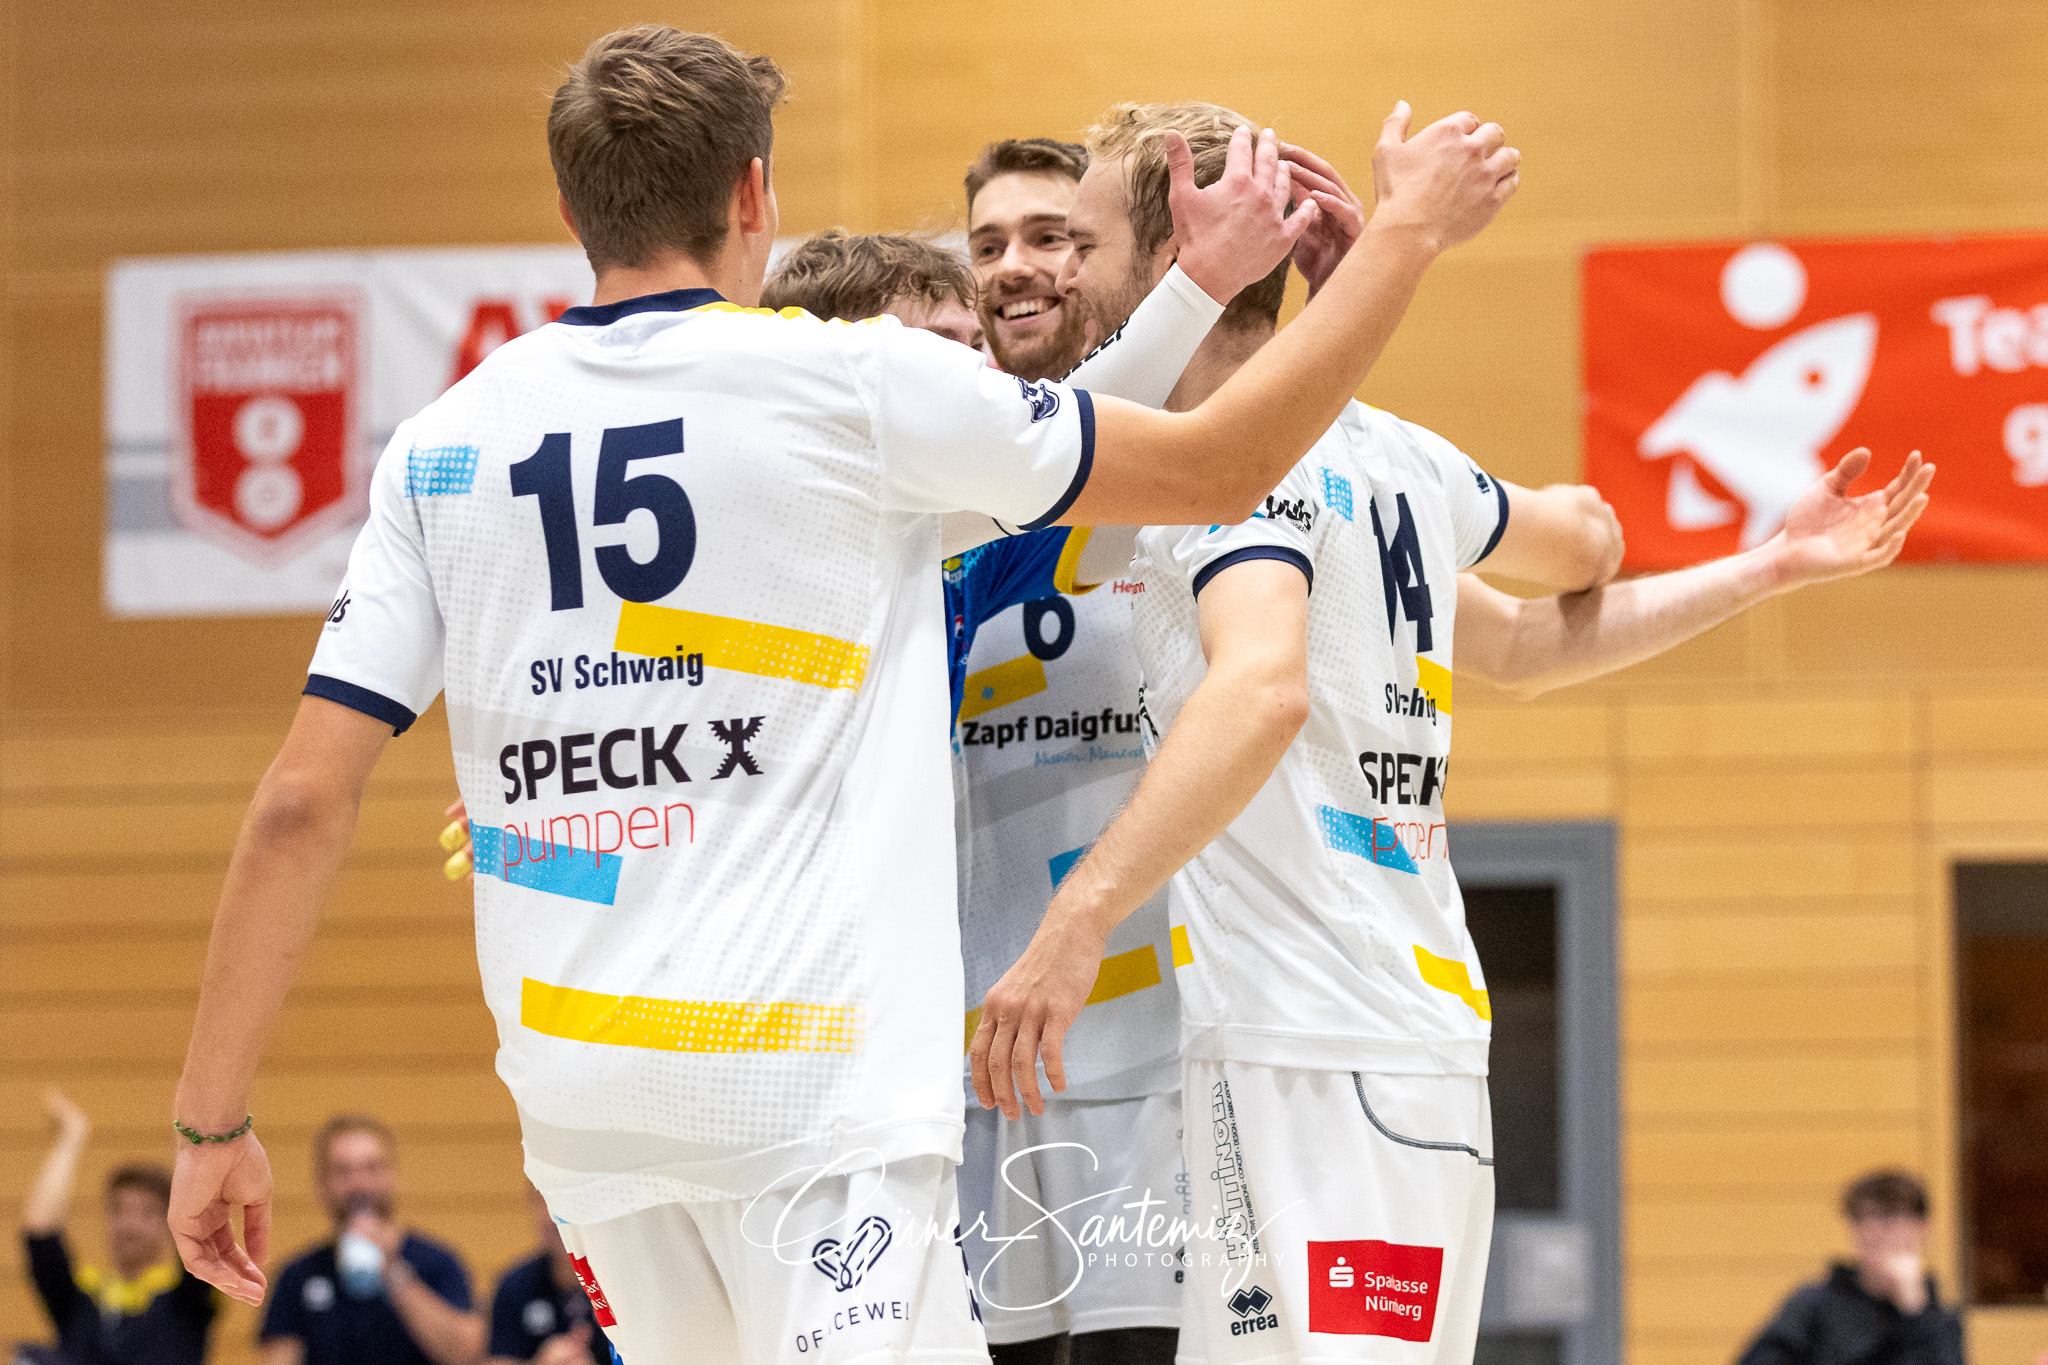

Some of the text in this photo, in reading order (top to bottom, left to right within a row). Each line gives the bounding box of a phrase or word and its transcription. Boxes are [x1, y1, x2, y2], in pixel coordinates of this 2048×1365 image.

[510, 417, 697, 611] 15
[530, 645, 704, 695] SV Schwaig
[500, 723, 692, 804] SPECK
[963, 716, 1028, 749] Zapf
[504, 803, 694, 882] pumpen
[1229, 1122, 1240, 1146] DESIGN
